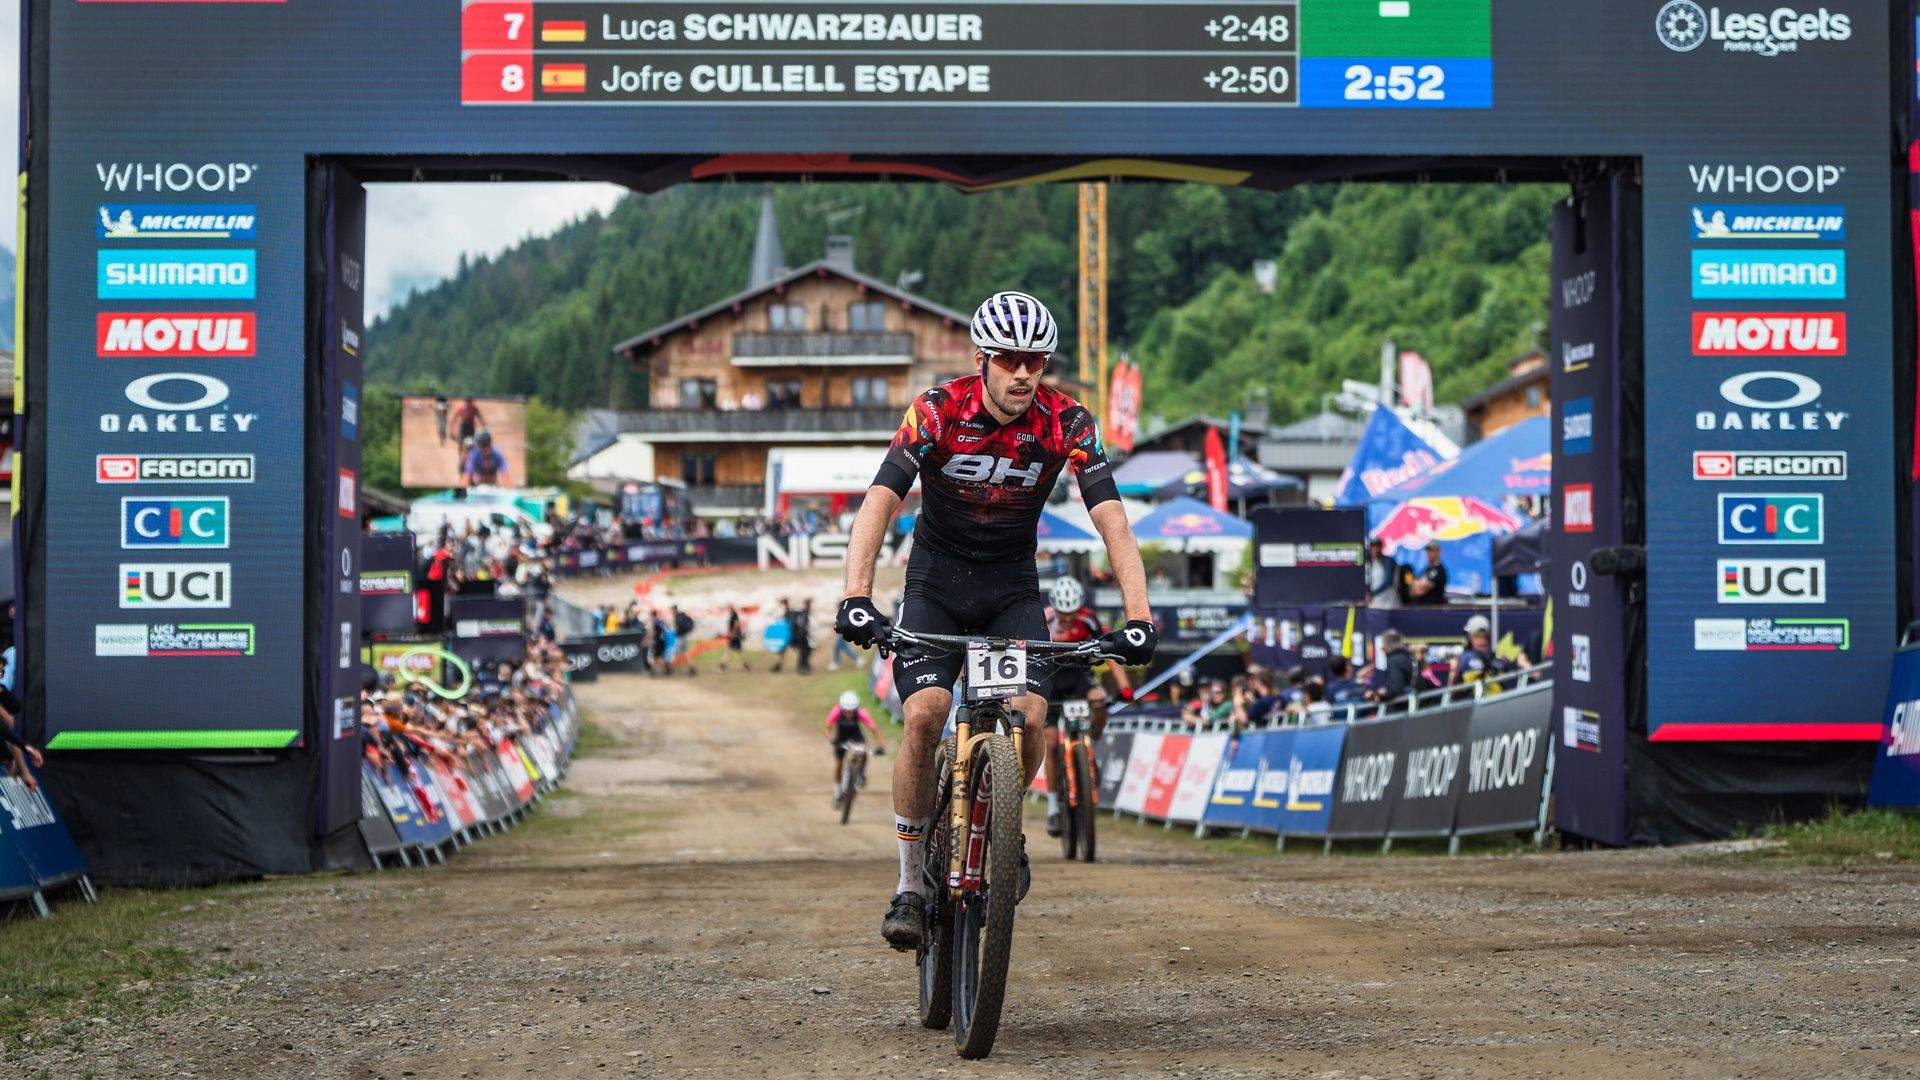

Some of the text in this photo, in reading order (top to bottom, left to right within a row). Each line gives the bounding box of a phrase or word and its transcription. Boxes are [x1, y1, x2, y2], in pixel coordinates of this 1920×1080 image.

[503, 13, 1290, 43] 7 Luca SCHWARZBAUER +2:48
[500, 65, 1290, 94] 8 Jofre CULLELL ESTAPE +2:50
[1344, 64, 1446, 101] 2:52
[96, 162, 253, 192] WHOOP
[1689, 164, 1842, 193] WHOOP
[140, 214, 255, 230] MICHELIN
[1732, 216, 1842, 232] MICHELIN
[106, 262, 249, 286] SHIMANO
[1699, 262, 1837, 285] SHIMANO
[104, 318, 249, 352] MOTUL
[1698, 318, 1840, 351] MOTUL
[100, 413, 254, 432] OAKLEY
[1696, 412, 1845, 430] OAKLEY
[141, 460, 249, 478] FACOM
[941, 453, 1043, 487] BH
[1737, 458, 1841, 475] FACOM
[134, 507, 217, 537] CIC
[1730, 504, 1811, 534] CIC
[145, 571, 225, 602] UCI
[1743, 566, 1818, 597] UCI
[978, 655, 1019, 681] 16
[1403, 743, 1461, 800] WHOOP
[1468, 727, 1537, 794] WHOOP
[1342, 751, 1395, 803] WHOOP
